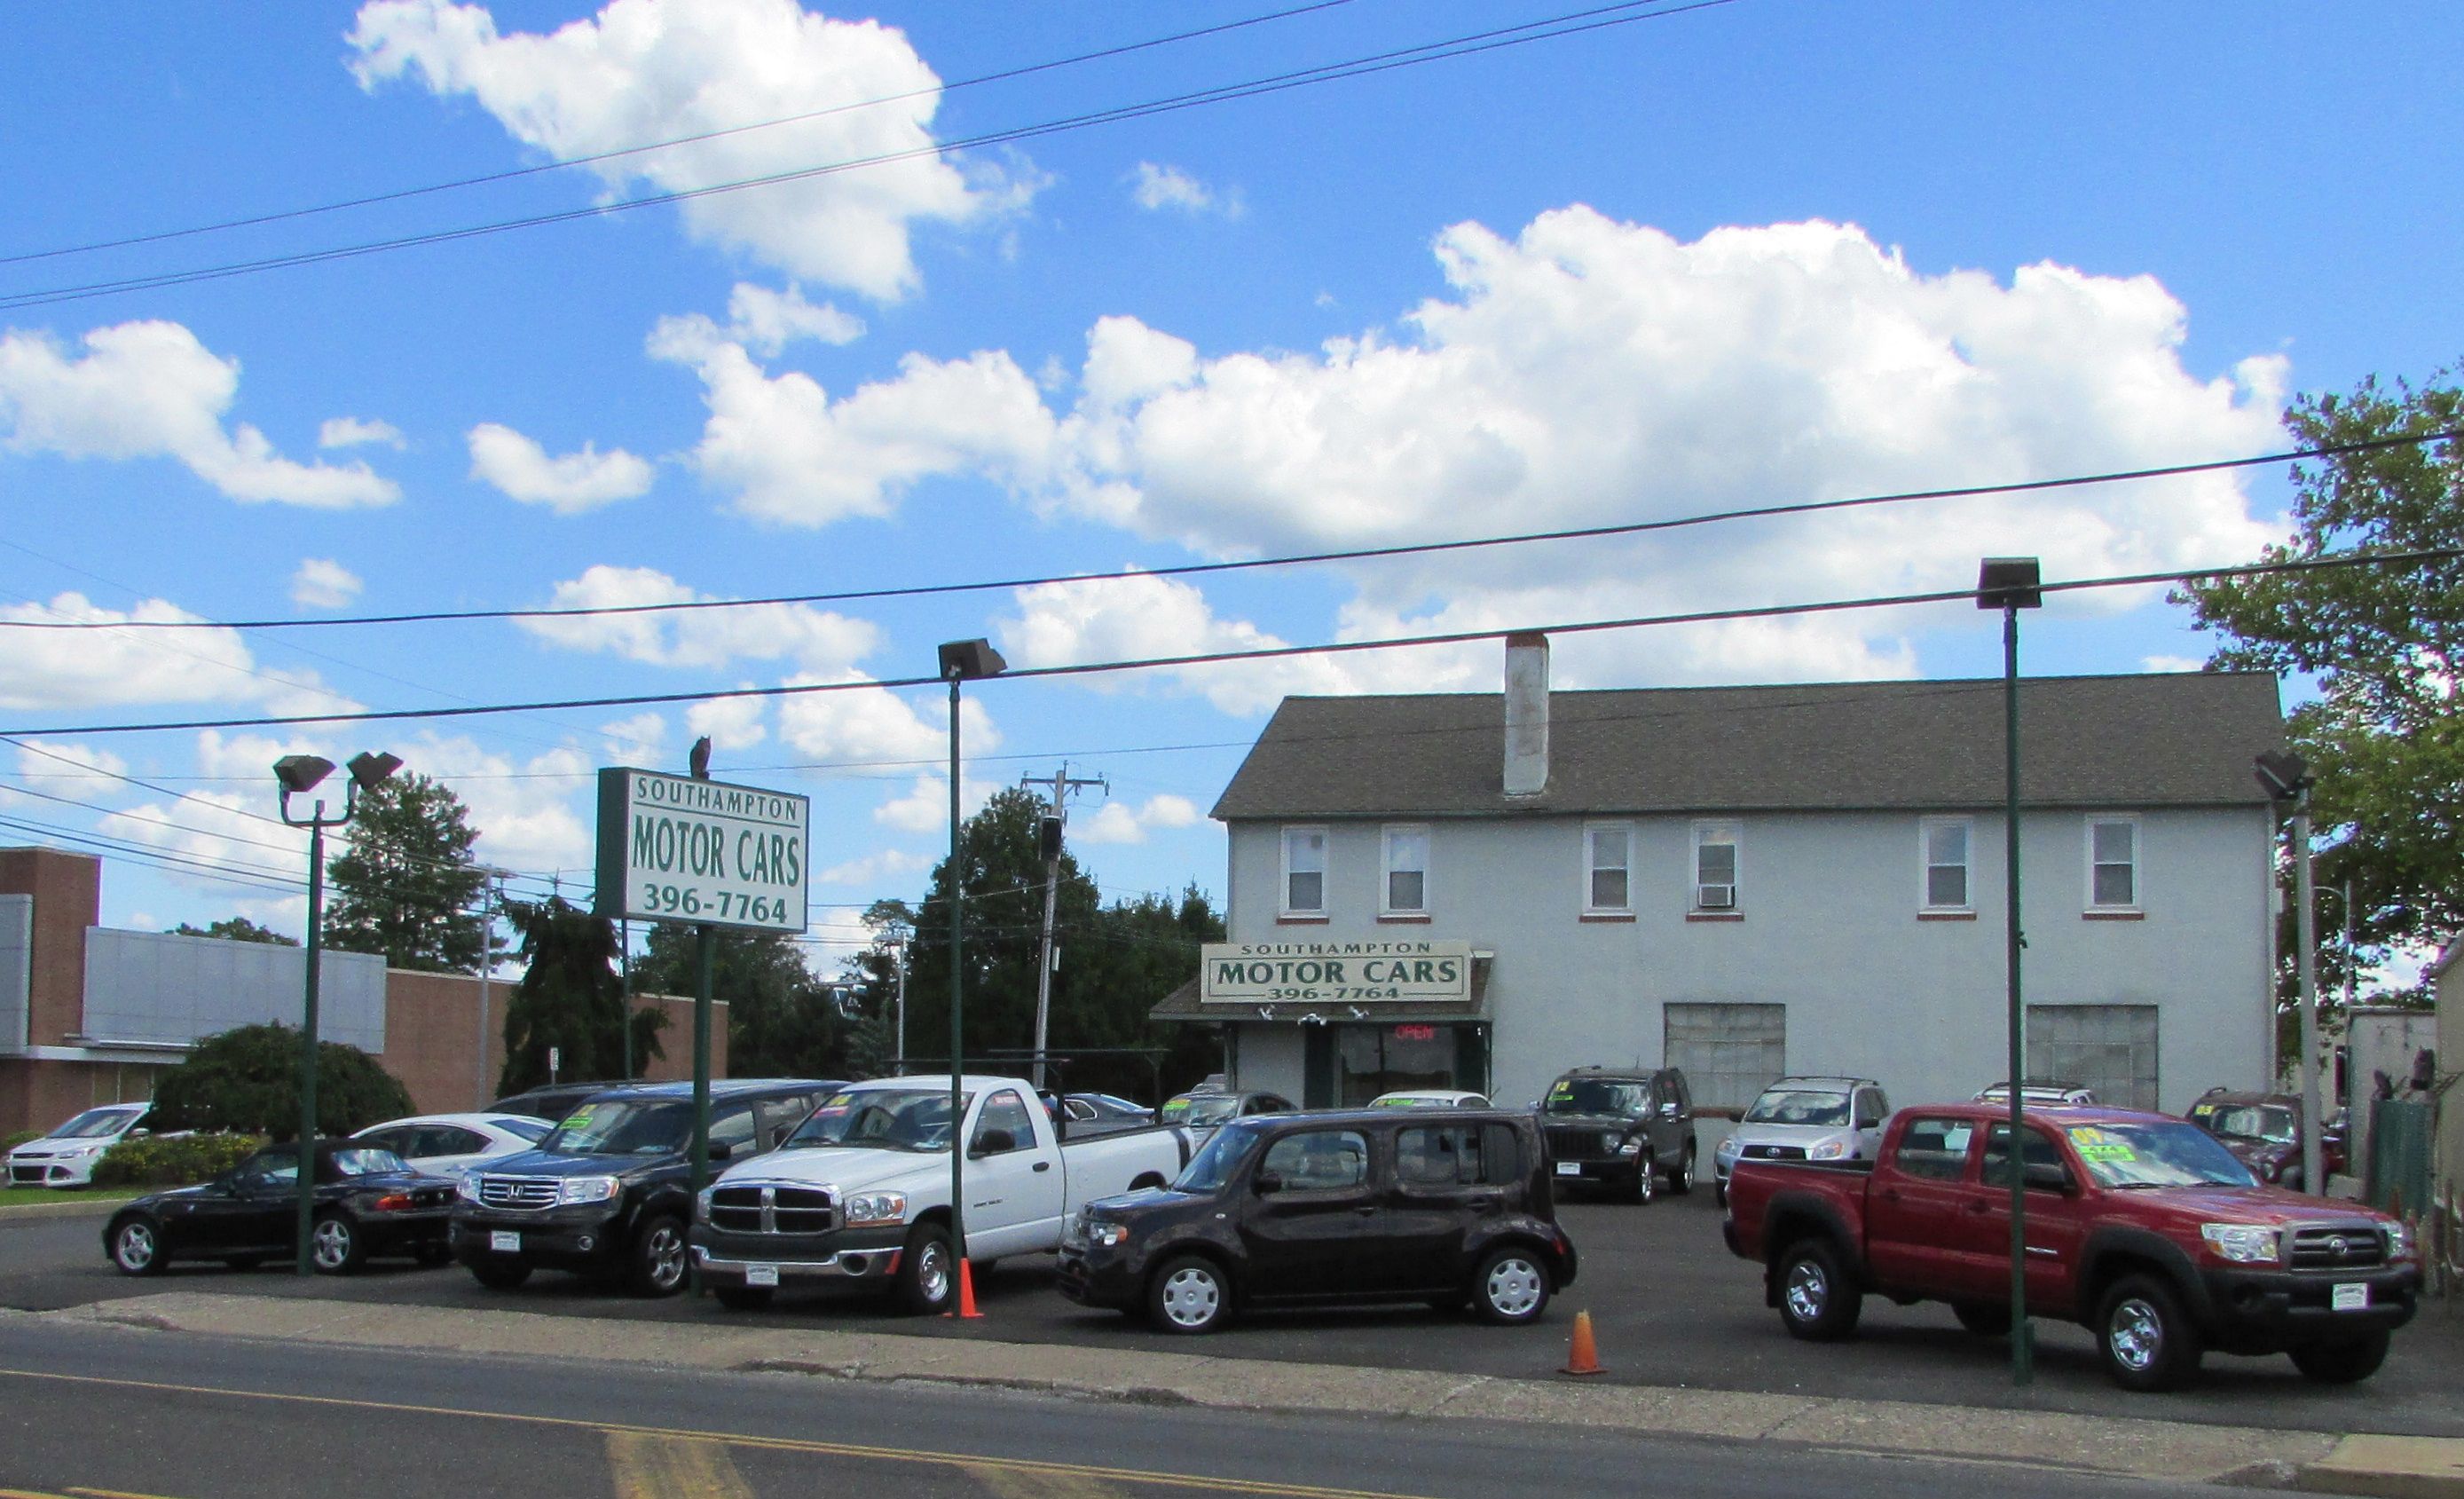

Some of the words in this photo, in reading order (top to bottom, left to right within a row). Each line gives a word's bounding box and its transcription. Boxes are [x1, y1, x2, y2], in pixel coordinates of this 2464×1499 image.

[637, 777, 798, 820] SOUTHAMPTON
[633, 815, 726, 879] MOTOR
[736, 830, 799, 888] CARS
[642, 883, 787, 924] 396-7764
[1241, 943, 1430, 955] SOUTHAMPTON
[1217, 961, 1347, 984] MOTOR
[1363, 960, 1457, 983] CARS
[1267, 987, 1399, 1000] 396-7764
[1395, 1024, 1435, 1040] OPEN
